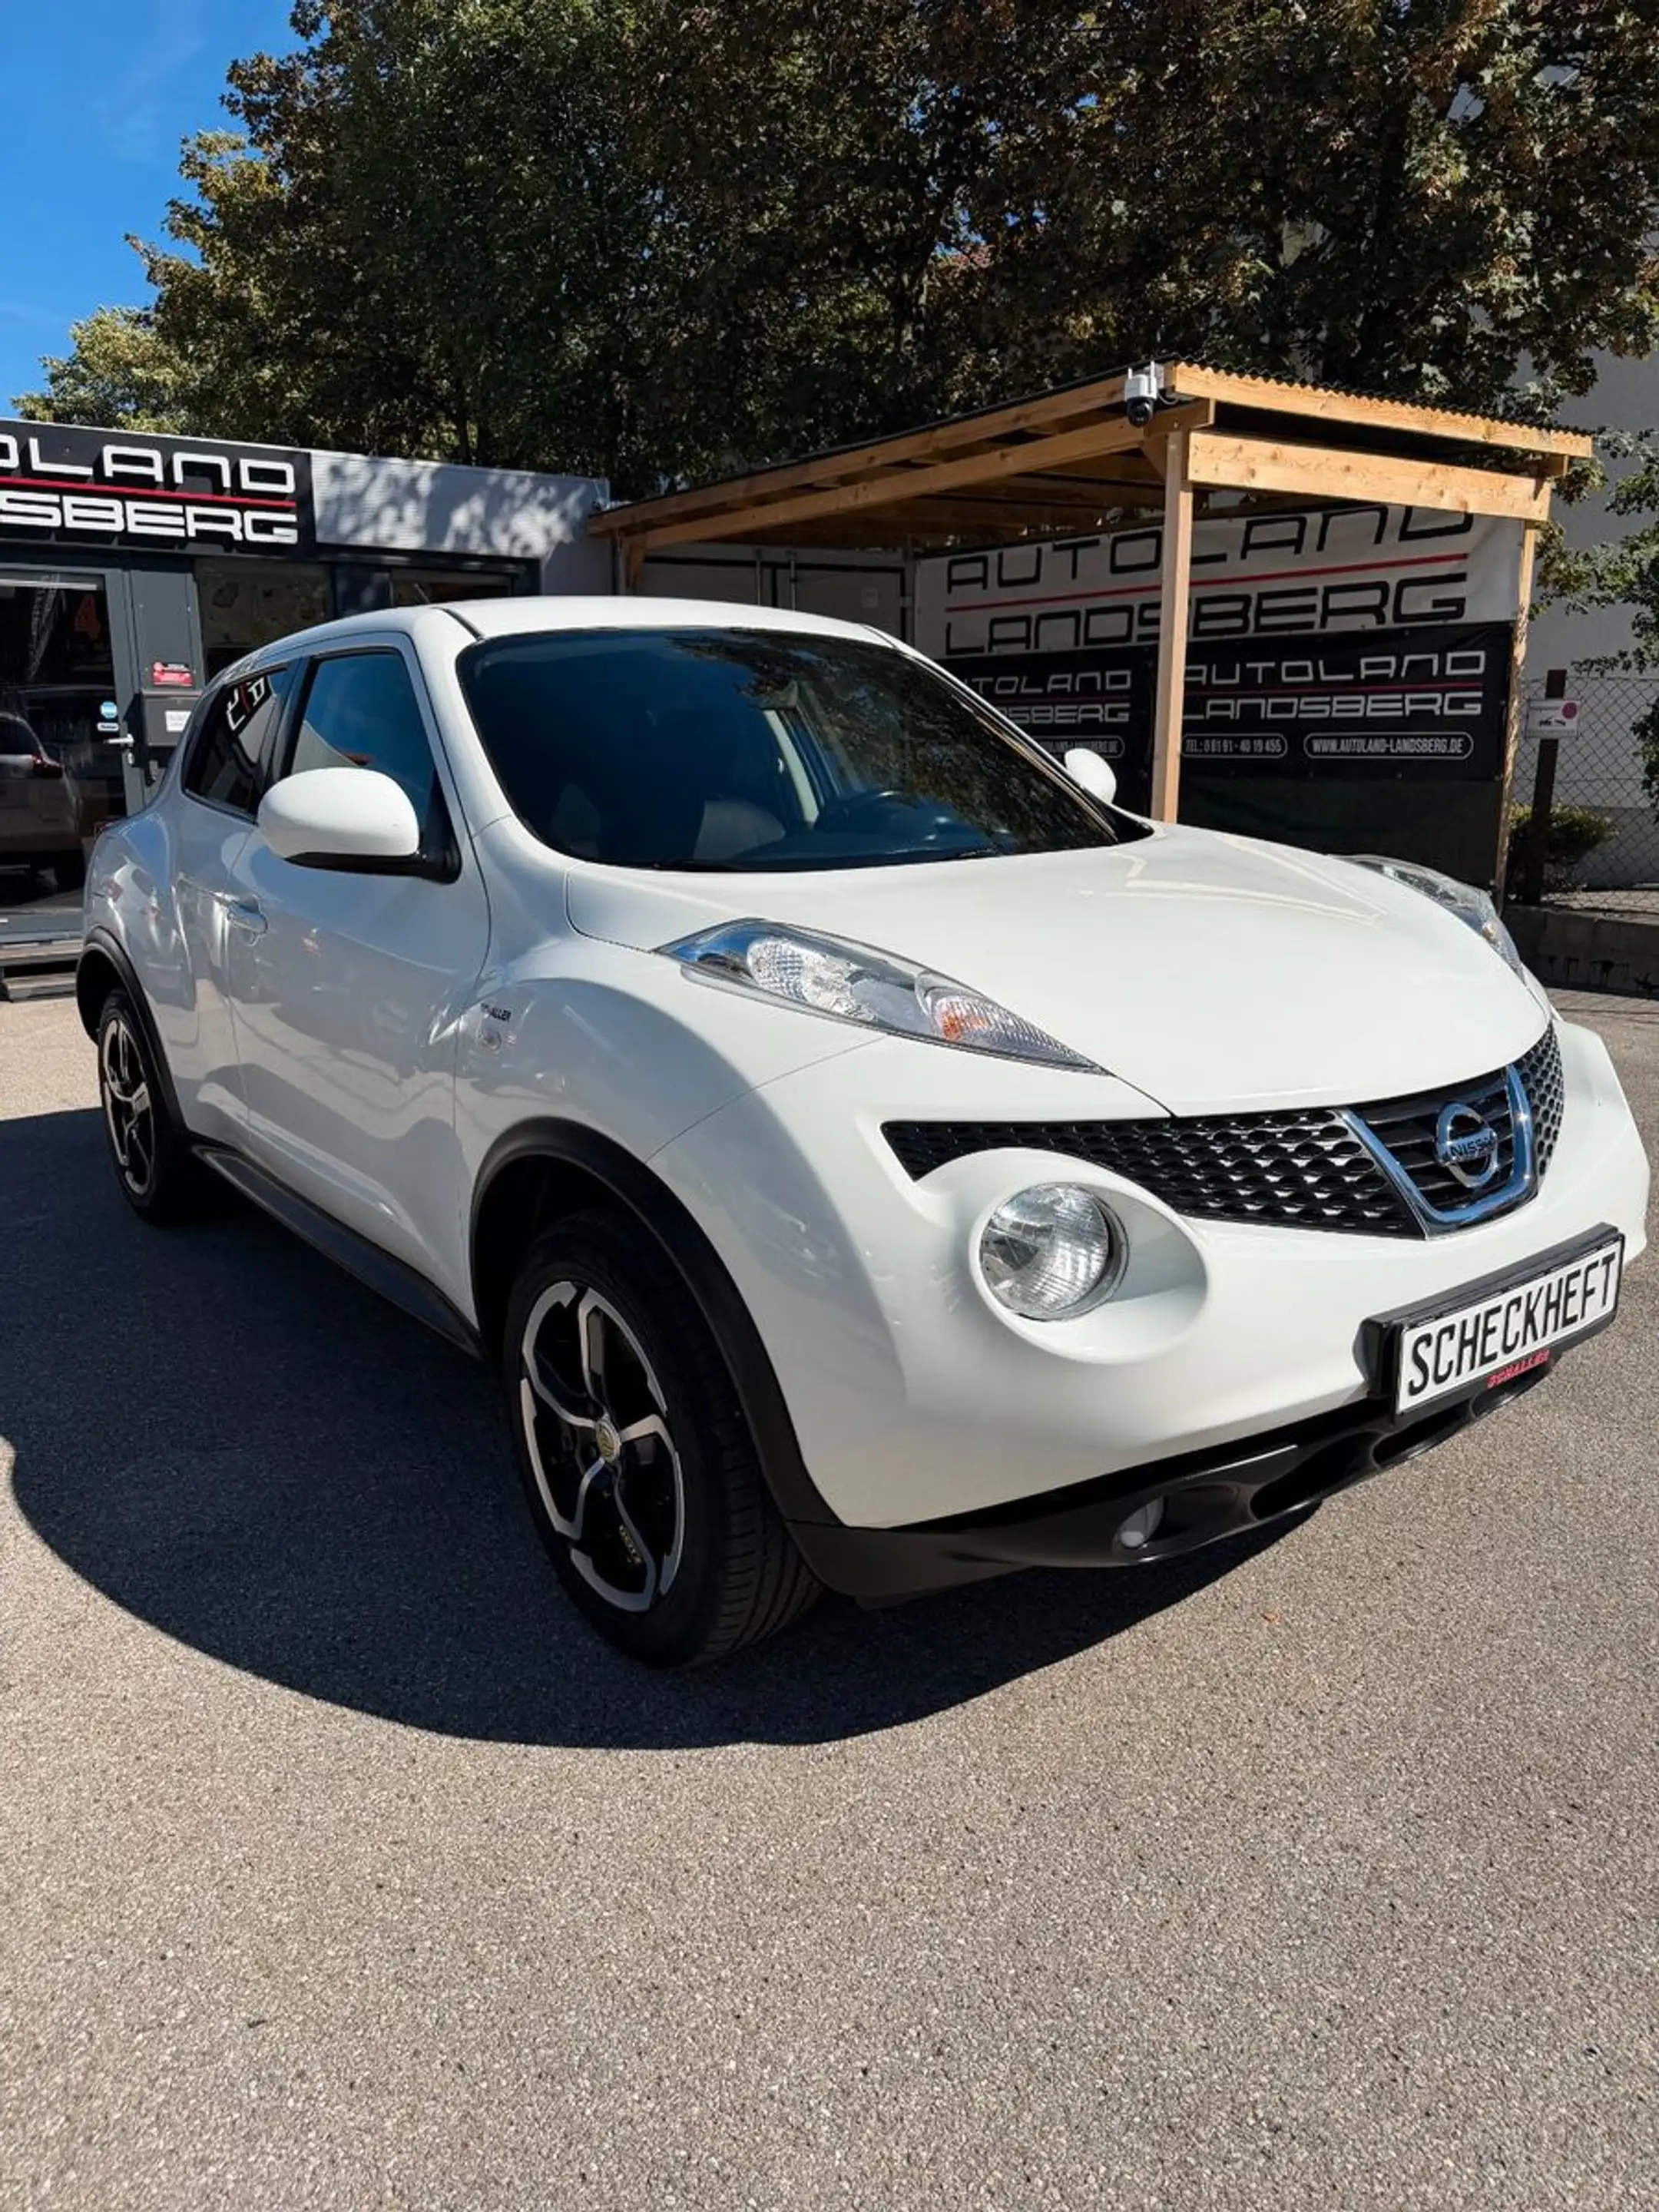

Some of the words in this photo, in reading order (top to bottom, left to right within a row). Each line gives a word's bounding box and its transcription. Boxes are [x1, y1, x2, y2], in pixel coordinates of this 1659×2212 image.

[963, 669, 1132, 694] TOLAND
[1184, 650, 1486, 686] AUTOLAND
[1407, 1252, 1616, 1396] SCHECKHEFT
